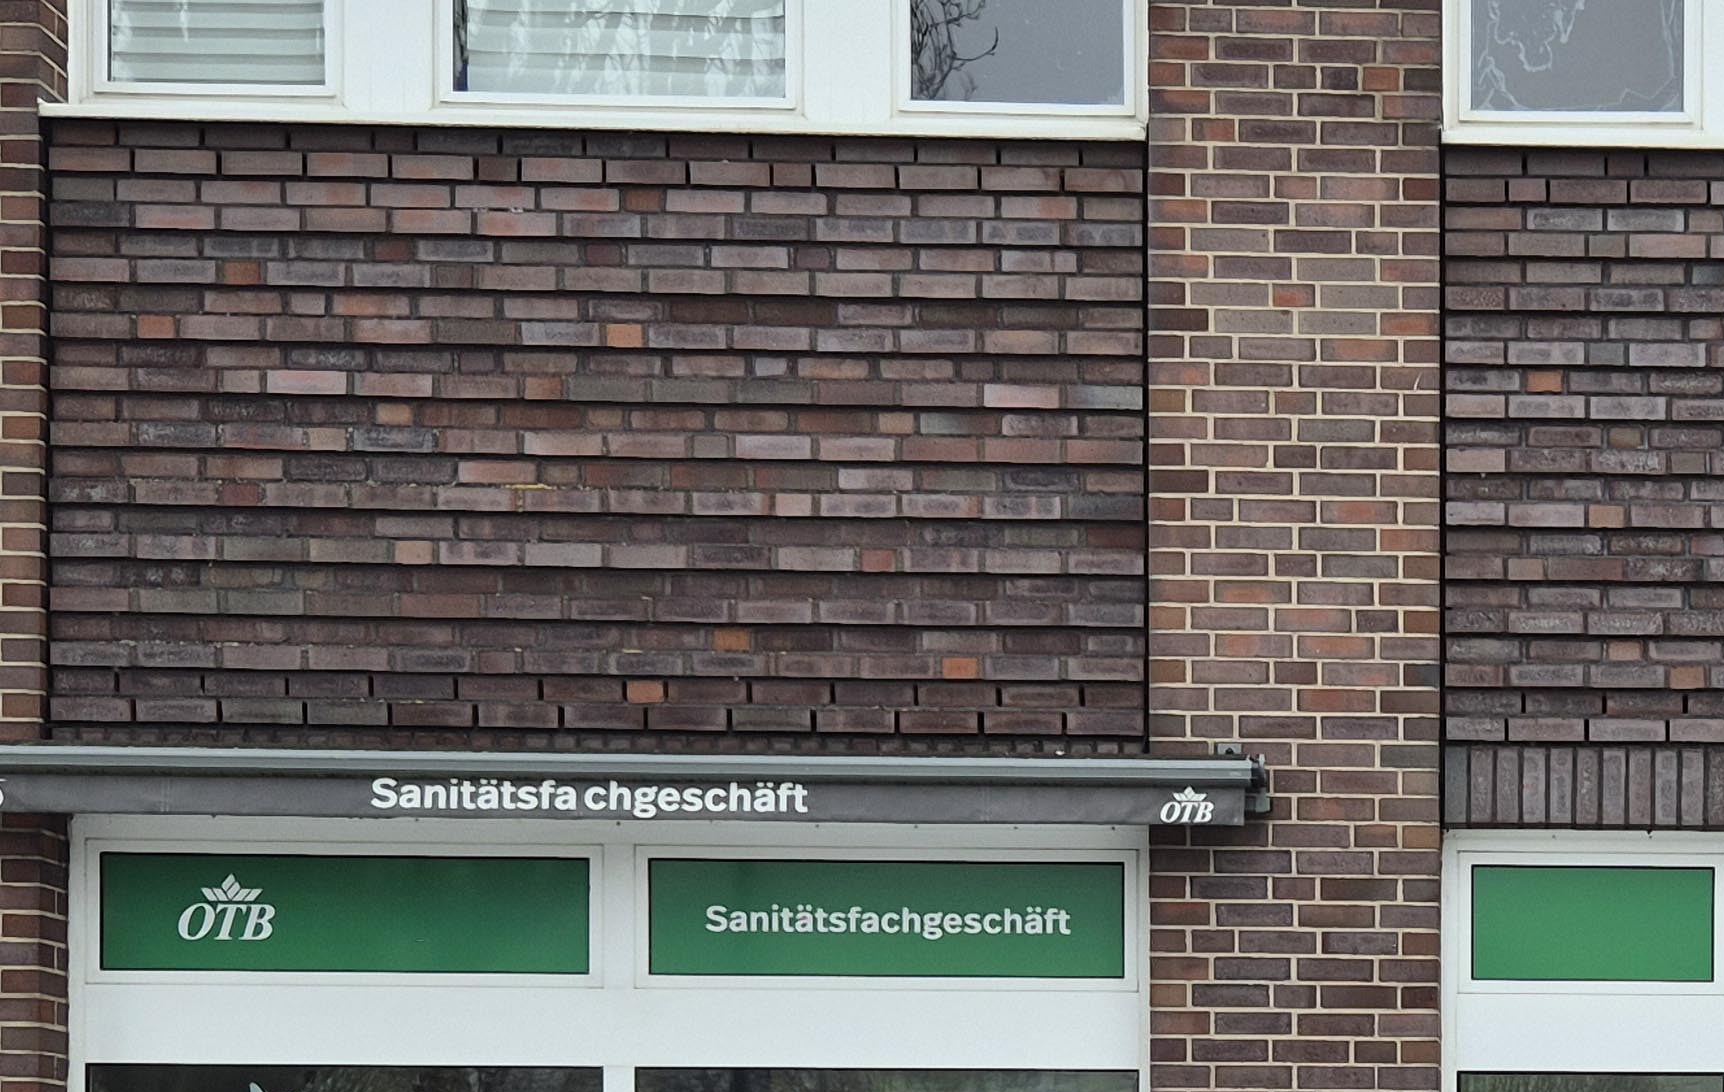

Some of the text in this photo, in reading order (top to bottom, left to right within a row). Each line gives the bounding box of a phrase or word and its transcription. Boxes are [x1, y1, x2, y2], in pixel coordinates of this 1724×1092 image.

[1160, 801, 1215, 824] OTB
[178, 903, 276, 941] OTB
[706, 905, 1070, 939] Sanitätsfachgeschäft
